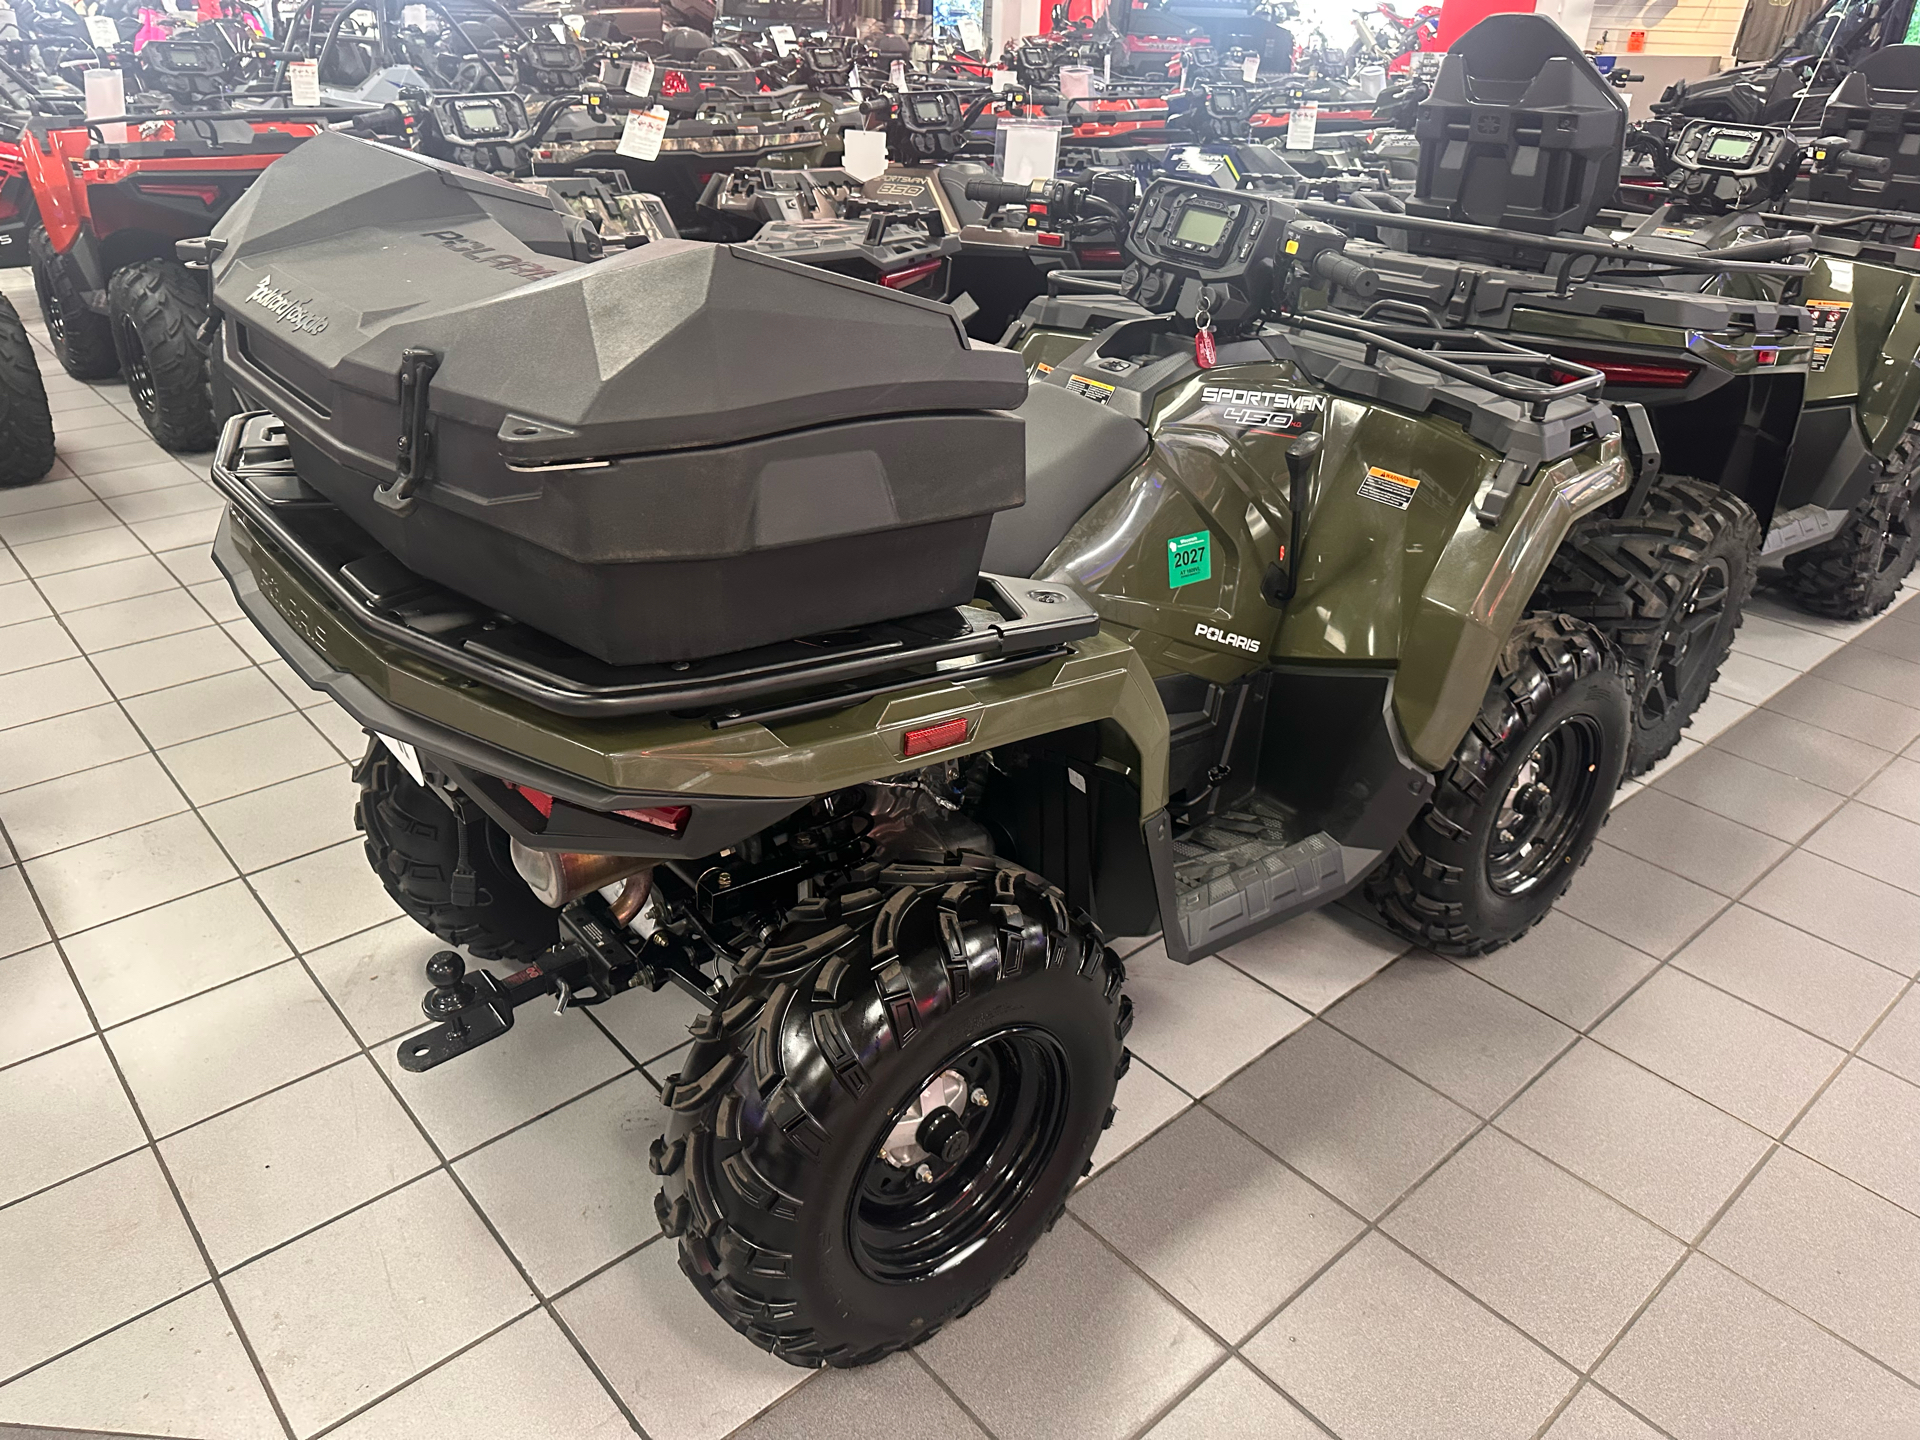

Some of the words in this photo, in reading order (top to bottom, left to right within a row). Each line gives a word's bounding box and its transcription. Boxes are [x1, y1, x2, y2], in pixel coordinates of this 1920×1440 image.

[876, 182, 925, 197] 850
[1201, 387, 1327, 412] SPORTSMAN
[1223, 407, 1294, 429] 450
[1385, 473, 1409, 484] WARNING
[1174, 546, 1206, 569] 2027
[1194, 623, 1261, 653] POLARIS
